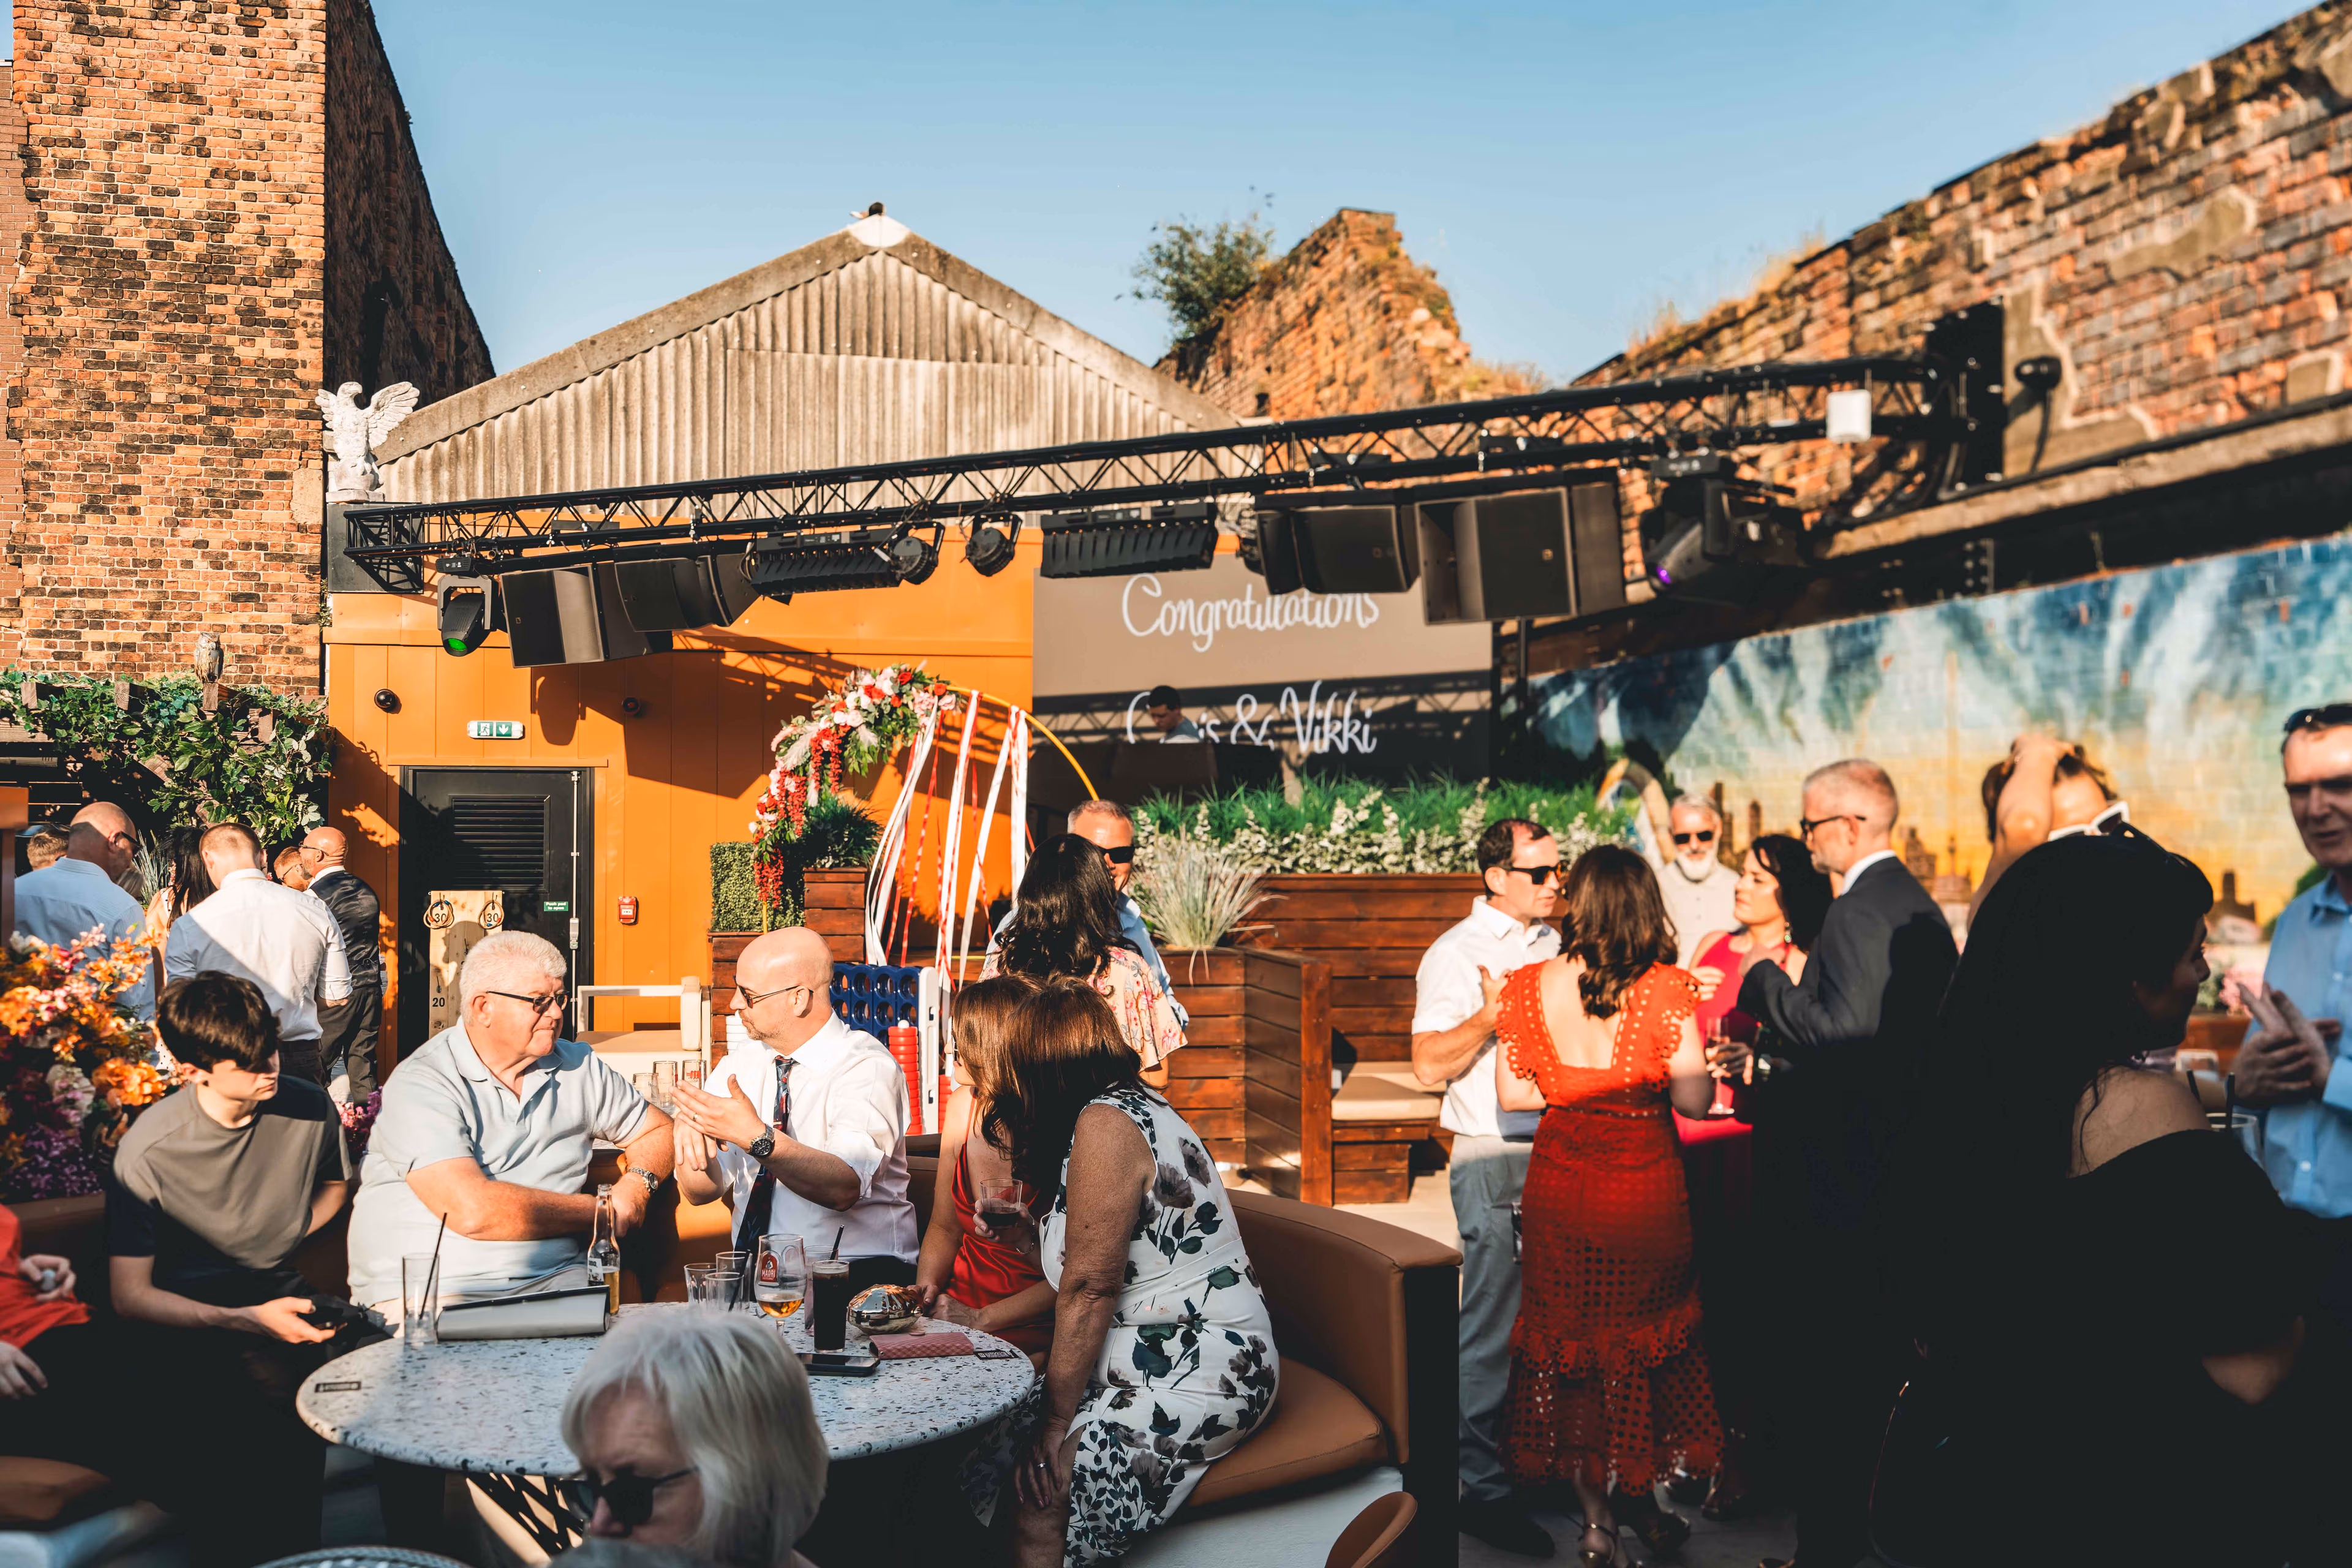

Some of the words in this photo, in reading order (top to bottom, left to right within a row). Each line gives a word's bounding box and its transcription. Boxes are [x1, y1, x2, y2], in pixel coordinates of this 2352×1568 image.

[1122, 573, 1379, 652] Congratulations
[1230, 693, 1275, 750] &
[1280, 680, 1378, 754] Vikki
[435, 913, 447, 922] 30
[487, 913, 499, 922] 30
[432, 997, 445, 1008] 20
